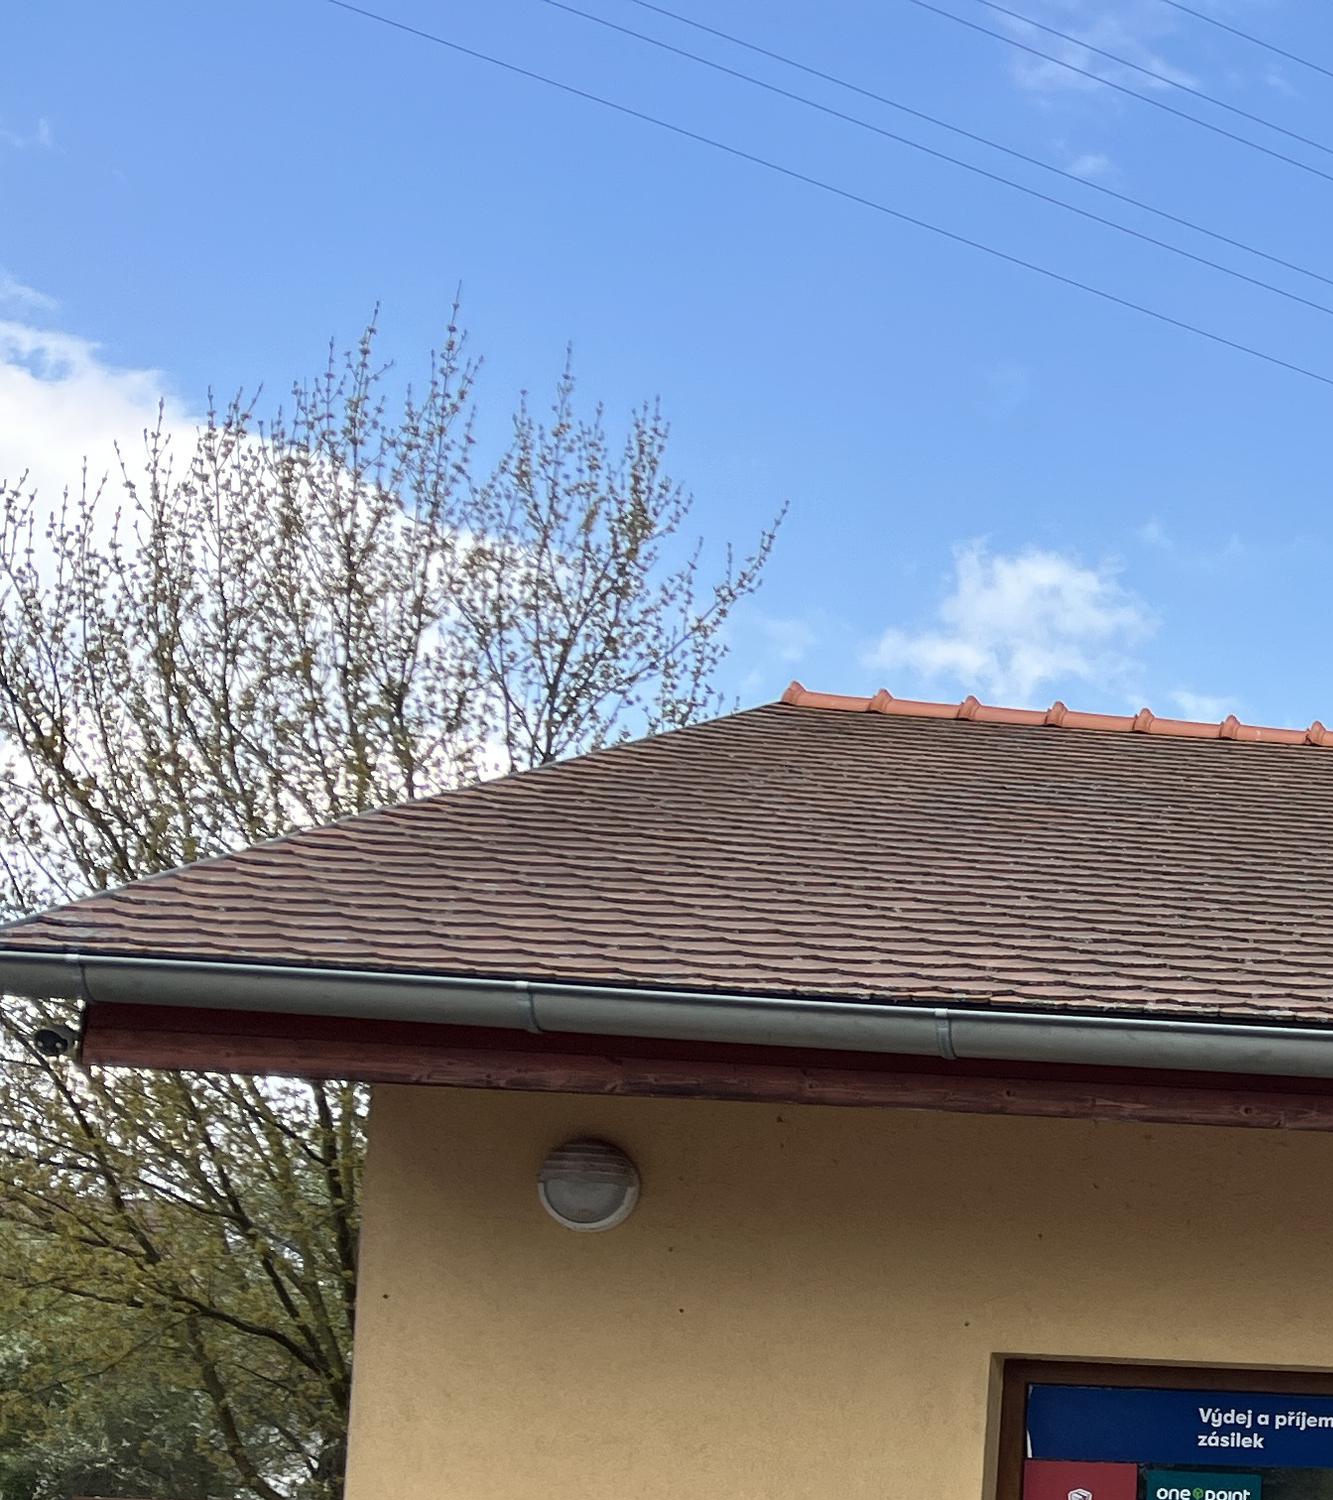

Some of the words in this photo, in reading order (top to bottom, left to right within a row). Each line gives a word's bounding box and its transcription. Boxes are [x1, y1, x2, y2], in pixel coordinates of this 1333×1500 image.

[1198, 1407, 1253, 1429] Výdej
[1257, 1414, 1270, 1426] a
[1197, 1431, 1265, 1449] zásilek
[1156, 1488, 1191, 1500] one
